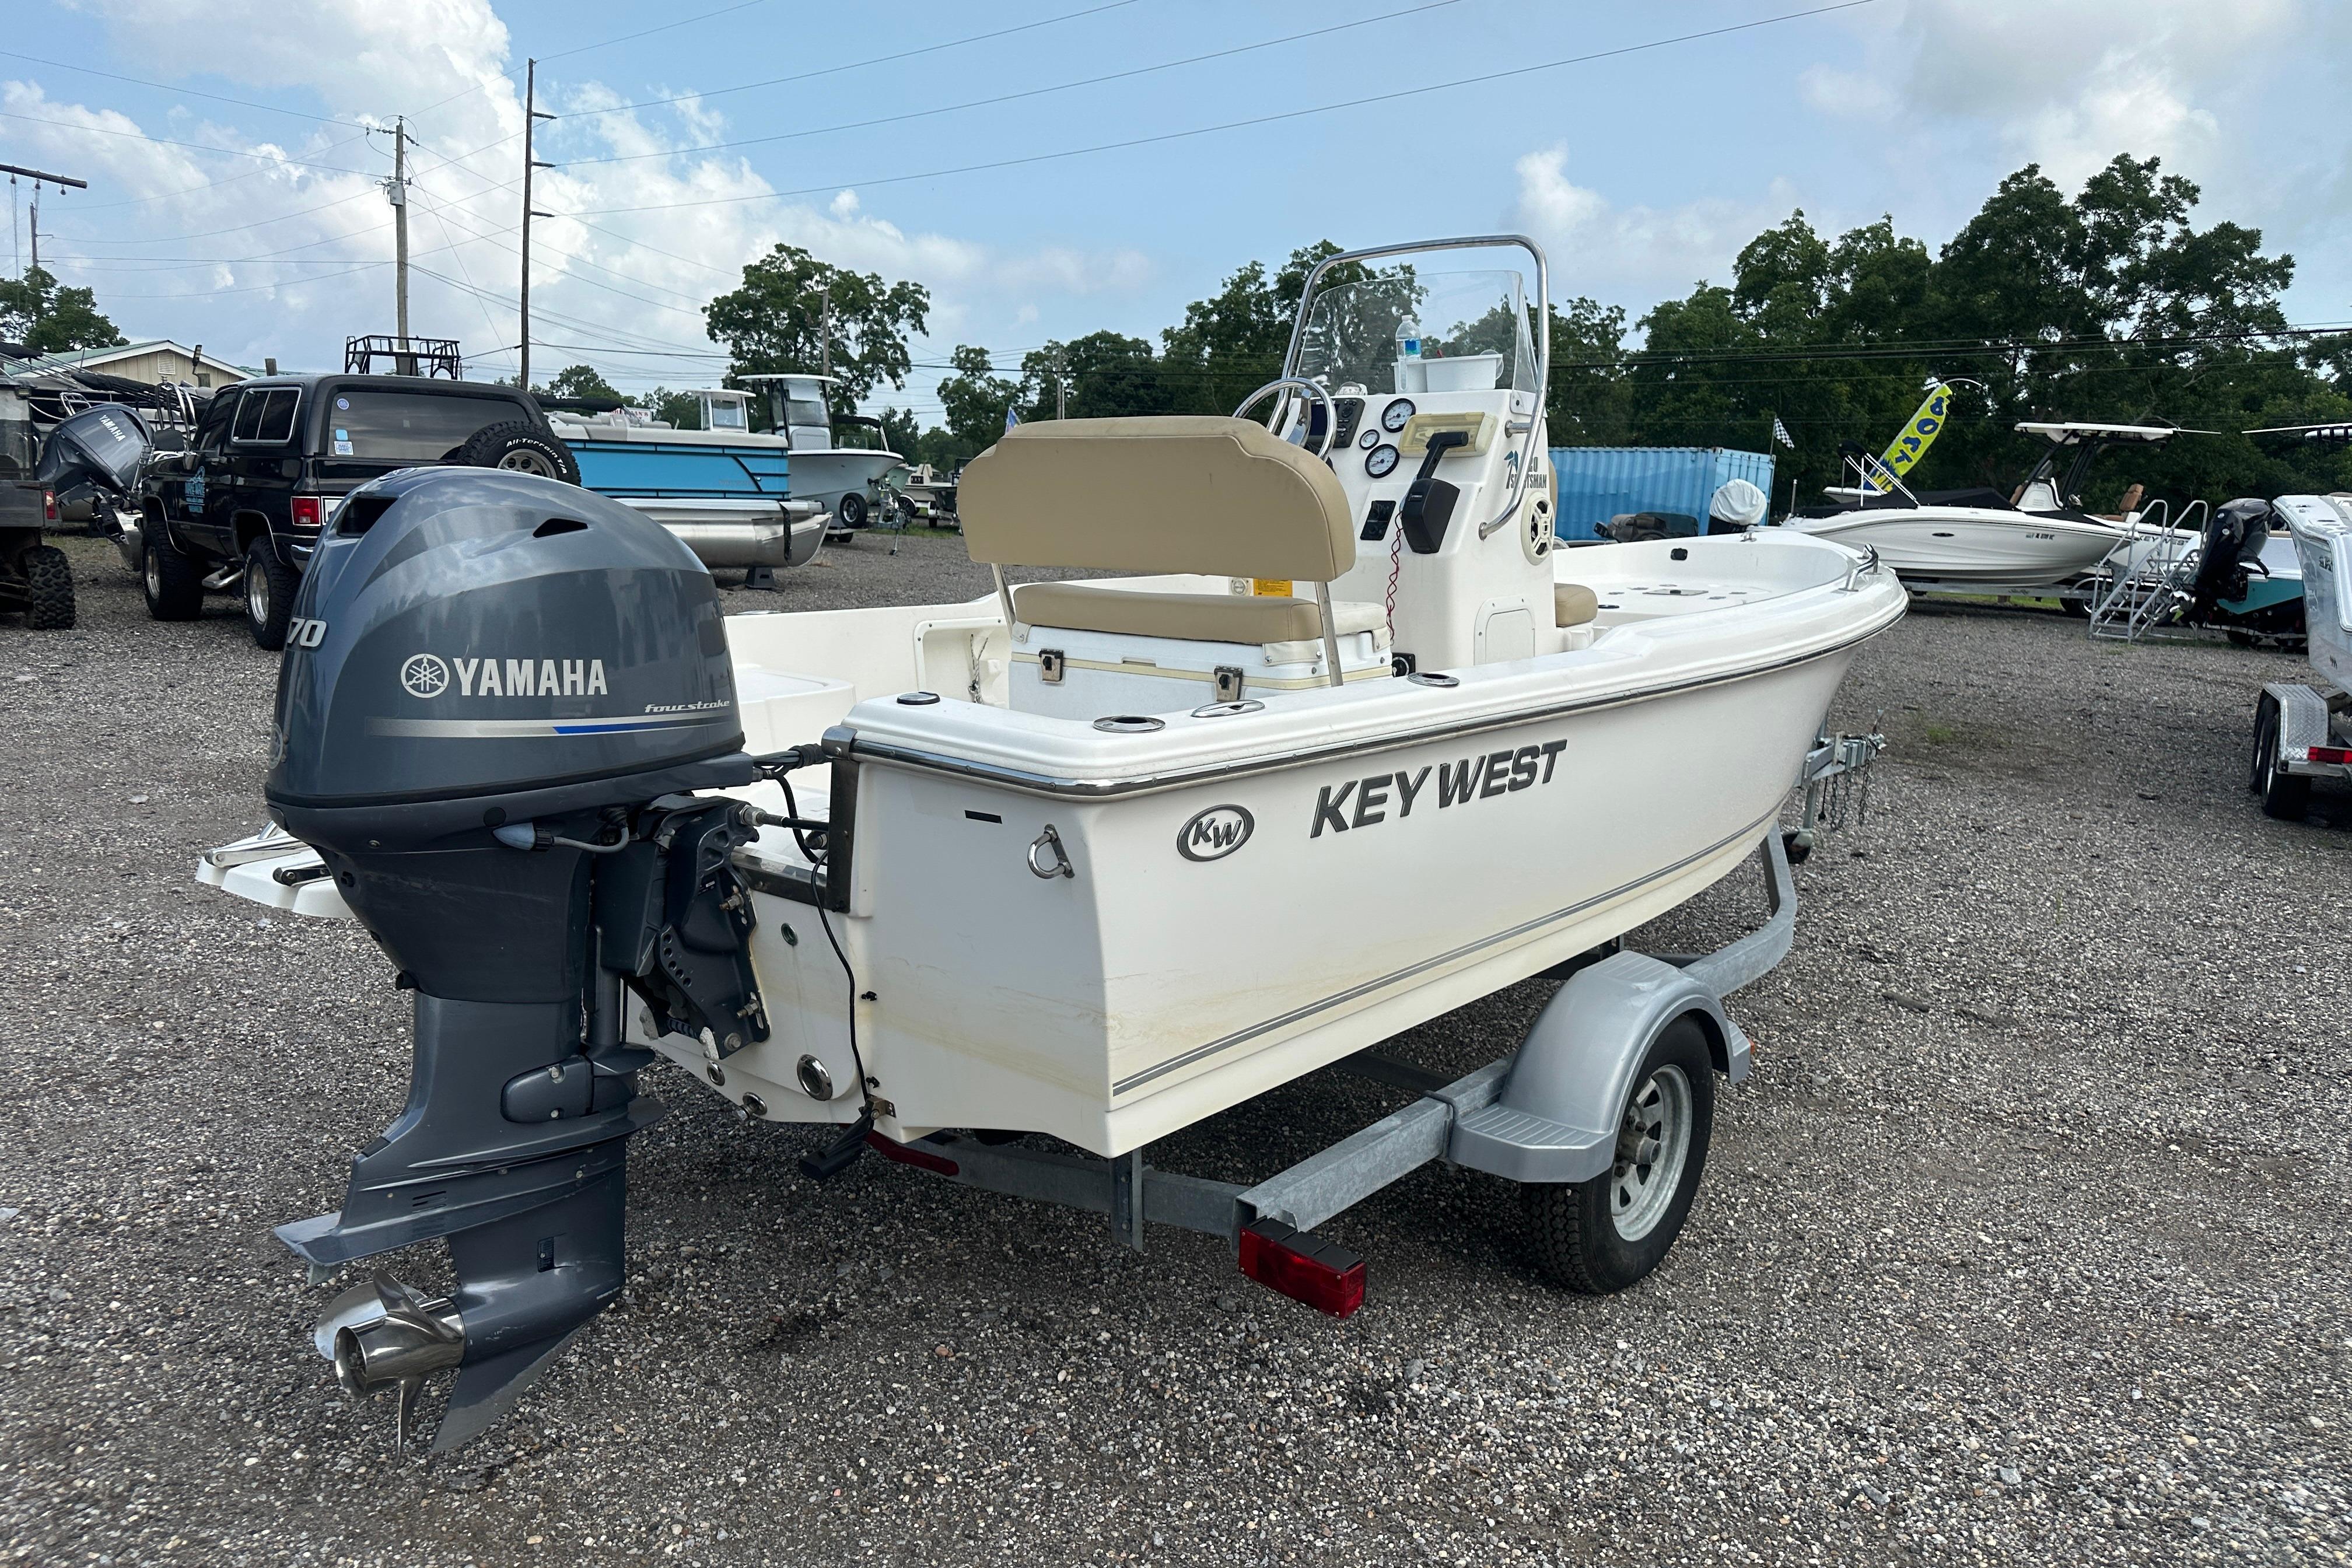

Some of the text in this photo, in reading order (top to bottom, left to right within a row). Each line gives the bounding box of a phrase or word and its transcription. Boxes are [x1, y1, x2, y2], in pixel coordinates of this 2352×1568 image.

[99, 414, 126, 442] YAMAHA
[506, 438, 568, 474] All-Terrain T/A
[2161, 537, 2189, 546] WES
[287, 617, 327, 648] 70
[453, 657, 608, 696] YAMAHA
[1310, 738, 1568, 839] KEY WEST
[1192, 818, 1242, 849] KW
